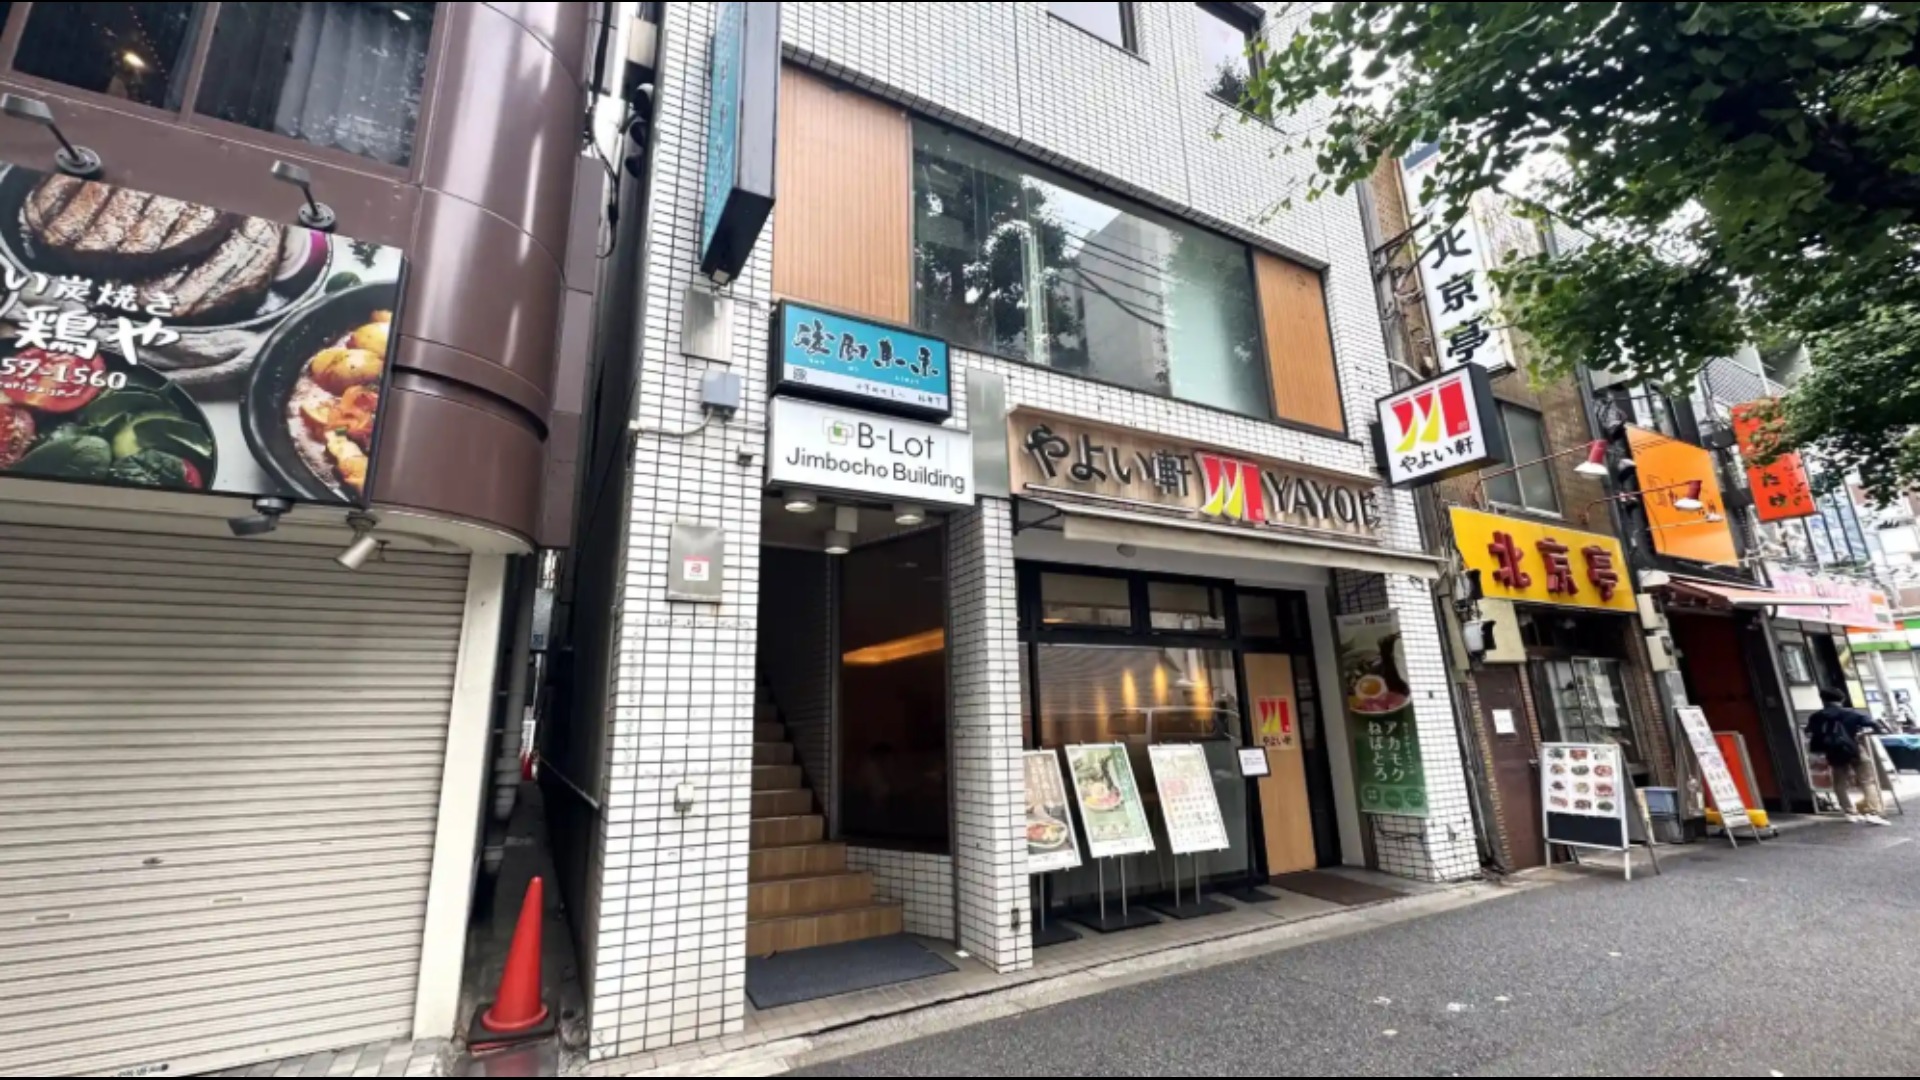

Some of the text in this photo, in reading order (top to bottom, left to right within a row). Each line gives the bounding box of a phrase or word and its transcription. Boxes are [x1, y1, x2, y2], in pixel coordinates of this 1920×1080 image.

[1430, 227, 1490, 364] 北京亭
[786, 446, 966, 495] Jimbocho Building
[858, 421, 935, 460] B-Lot
[1023, 423, 1192, 497] やよい軒
[1399, 435, 1475, 474] やよい軒
[1260, 468, 1371, 528] YAYOI
[1487, 530, 1619, 604] 北京亭
[1367, 720, 1388, 782] ねばとろ
[1383, 720, 1405, 783] アカモク
